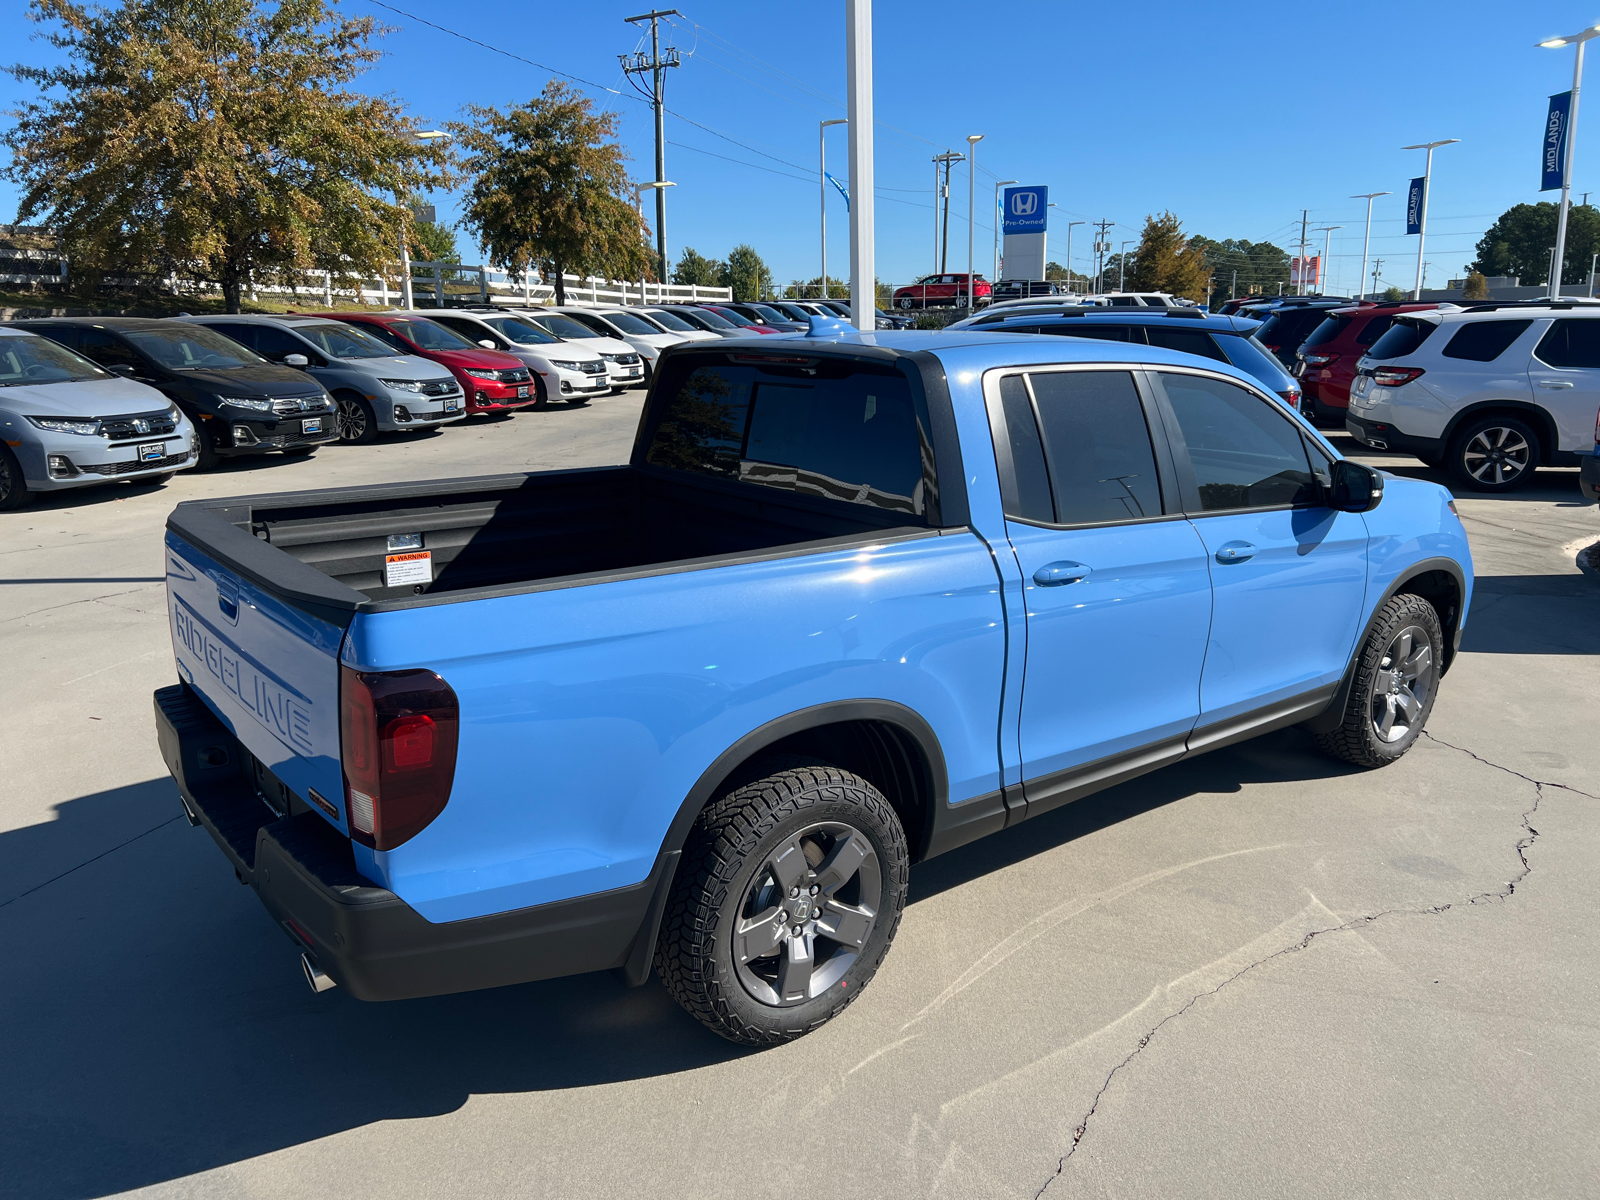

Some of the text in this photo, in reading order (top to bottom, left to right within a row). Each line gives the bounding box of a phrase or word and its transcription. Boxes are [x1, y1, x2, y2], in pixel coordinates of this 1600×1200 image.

[1547, 110, 1560, 172] MIDLANDS
[1005, 218, 1044, 226] Pre-Owned
[1409, 187, 1418, 225] MIDLANDS
[397, 553, 428, 561] WARNING
[174, 603, 314, 755] RIDGELINE
